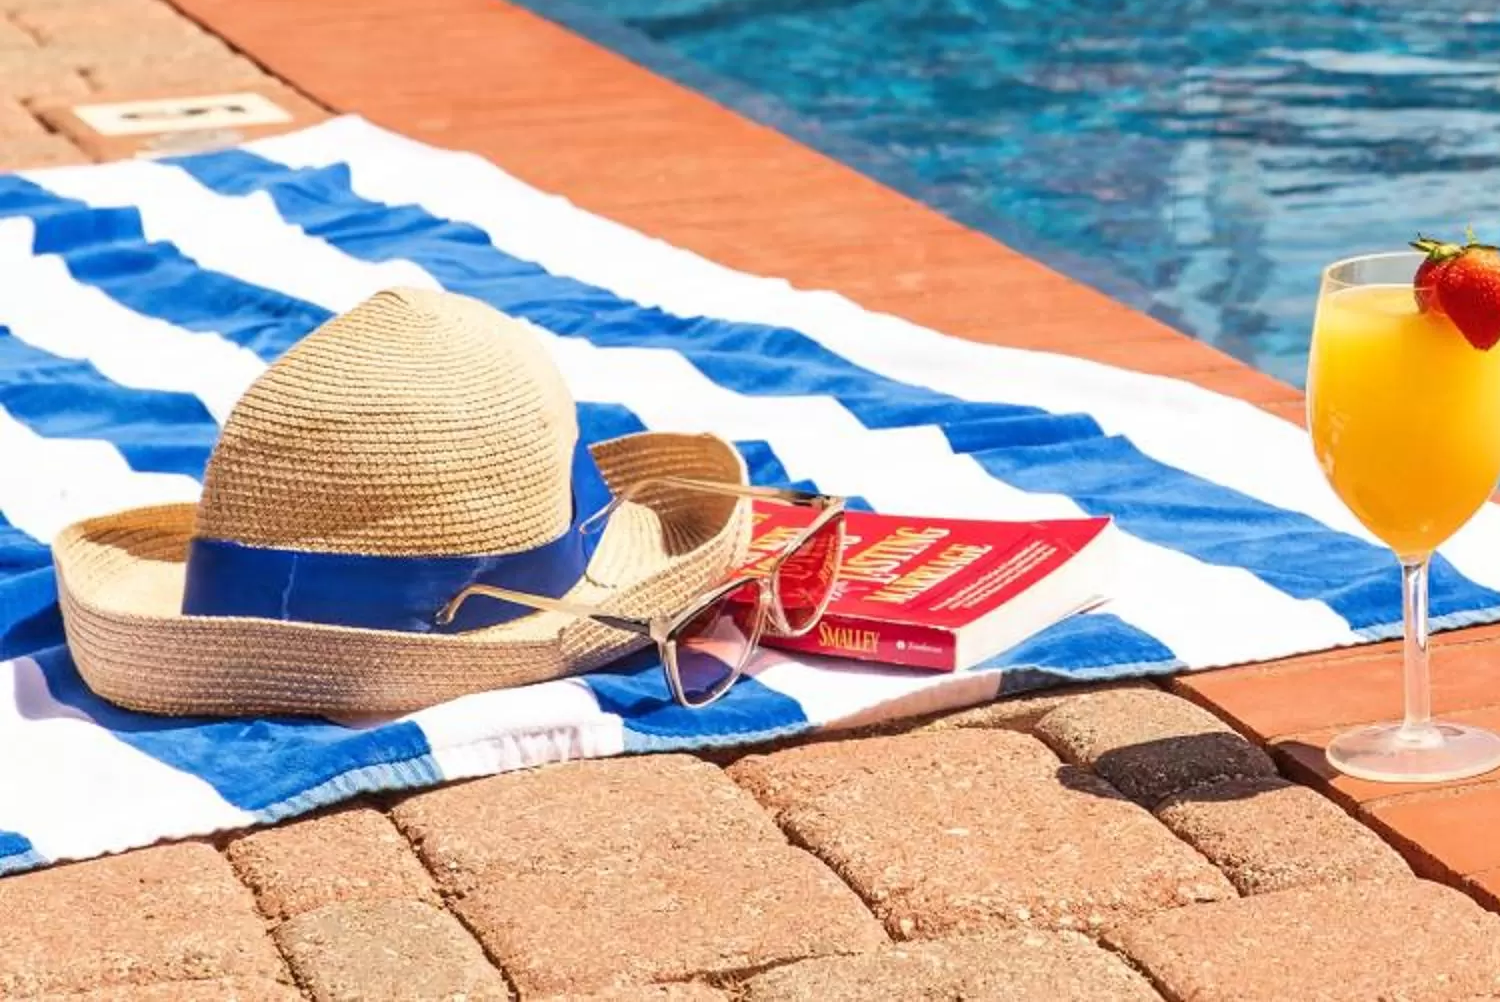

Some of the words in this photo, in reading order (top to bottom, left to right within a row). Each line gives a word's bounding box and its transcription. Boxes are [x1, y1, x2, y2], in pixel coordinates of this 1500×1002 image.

[838, 527, 950, 584] LASTING
[862, 543, 993, 604] MARRIAGE
[818, 621, 880, 653] SMALLEY
